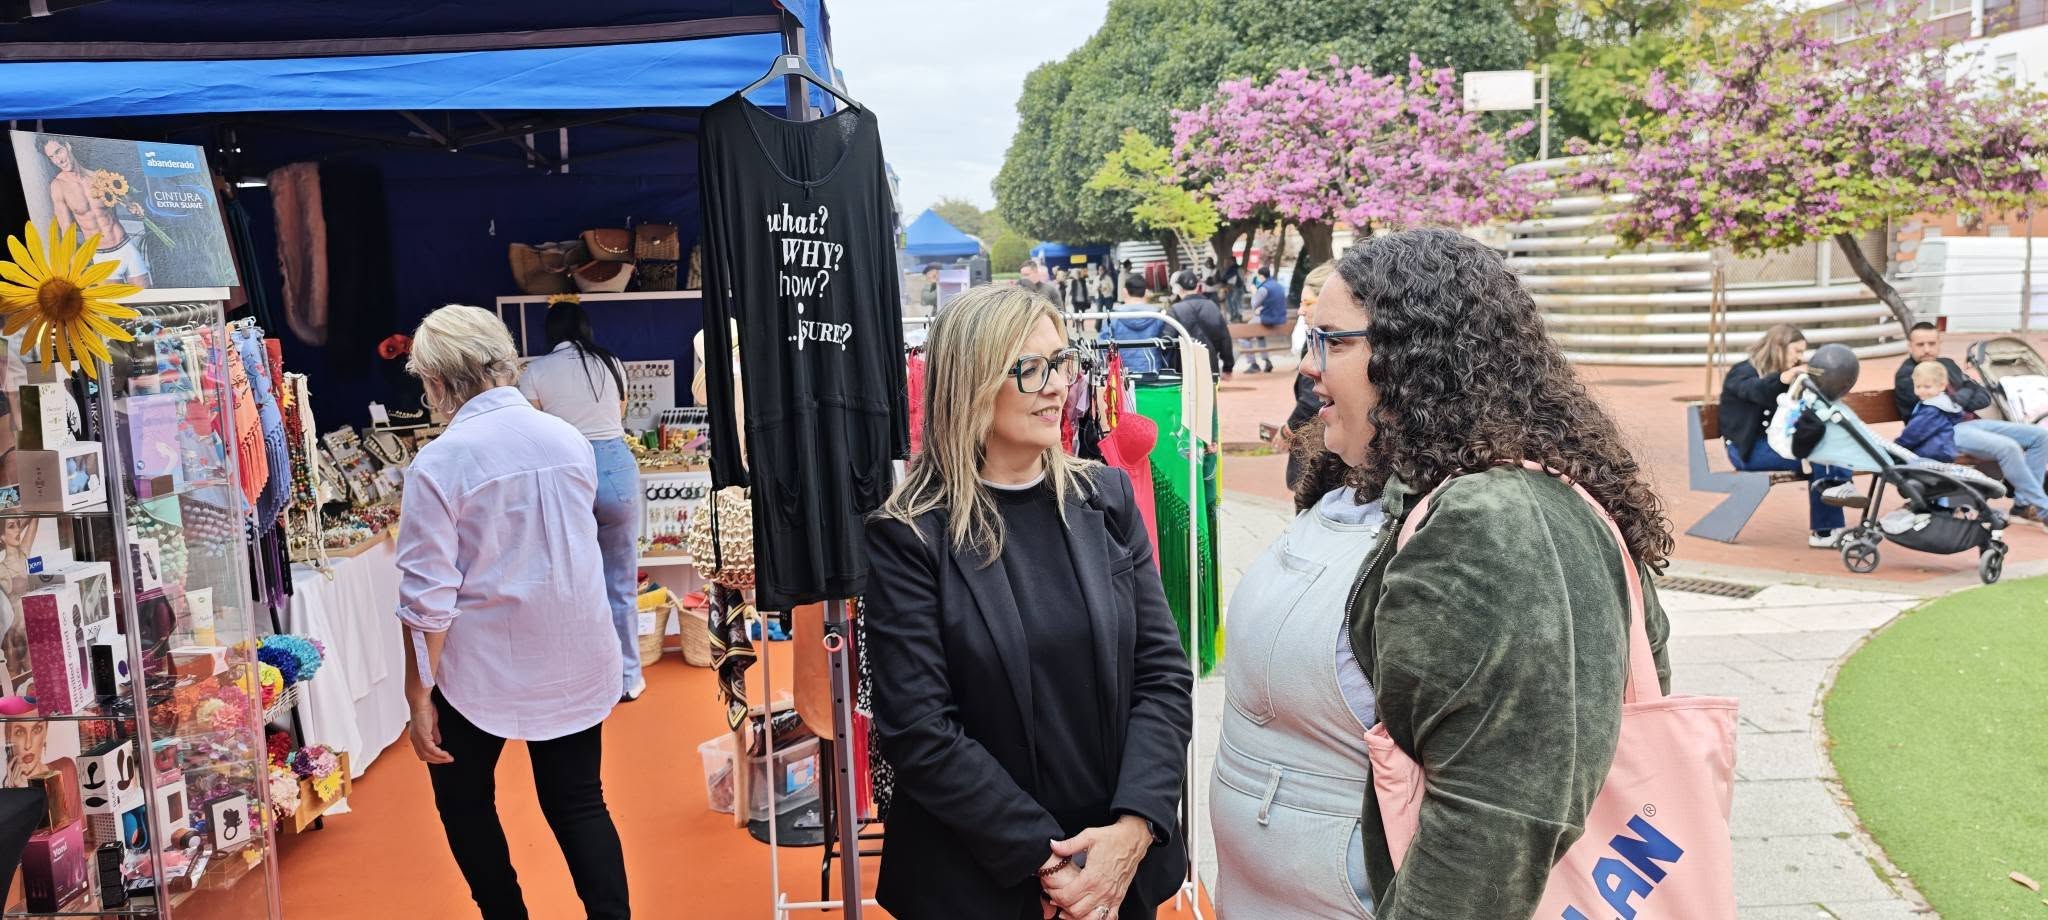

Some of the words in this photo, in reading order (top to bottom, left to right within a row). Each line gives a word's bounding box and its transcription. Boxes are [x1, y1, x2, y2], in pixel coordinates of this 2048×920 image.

[147, 158, 195, 169] abanderado
[154, 191, 203, 202] CINTURA
[767, 202, 829, 235] what?
[781, 238, 844, 271] WHY?
[779, 270, 830, 298] how?
